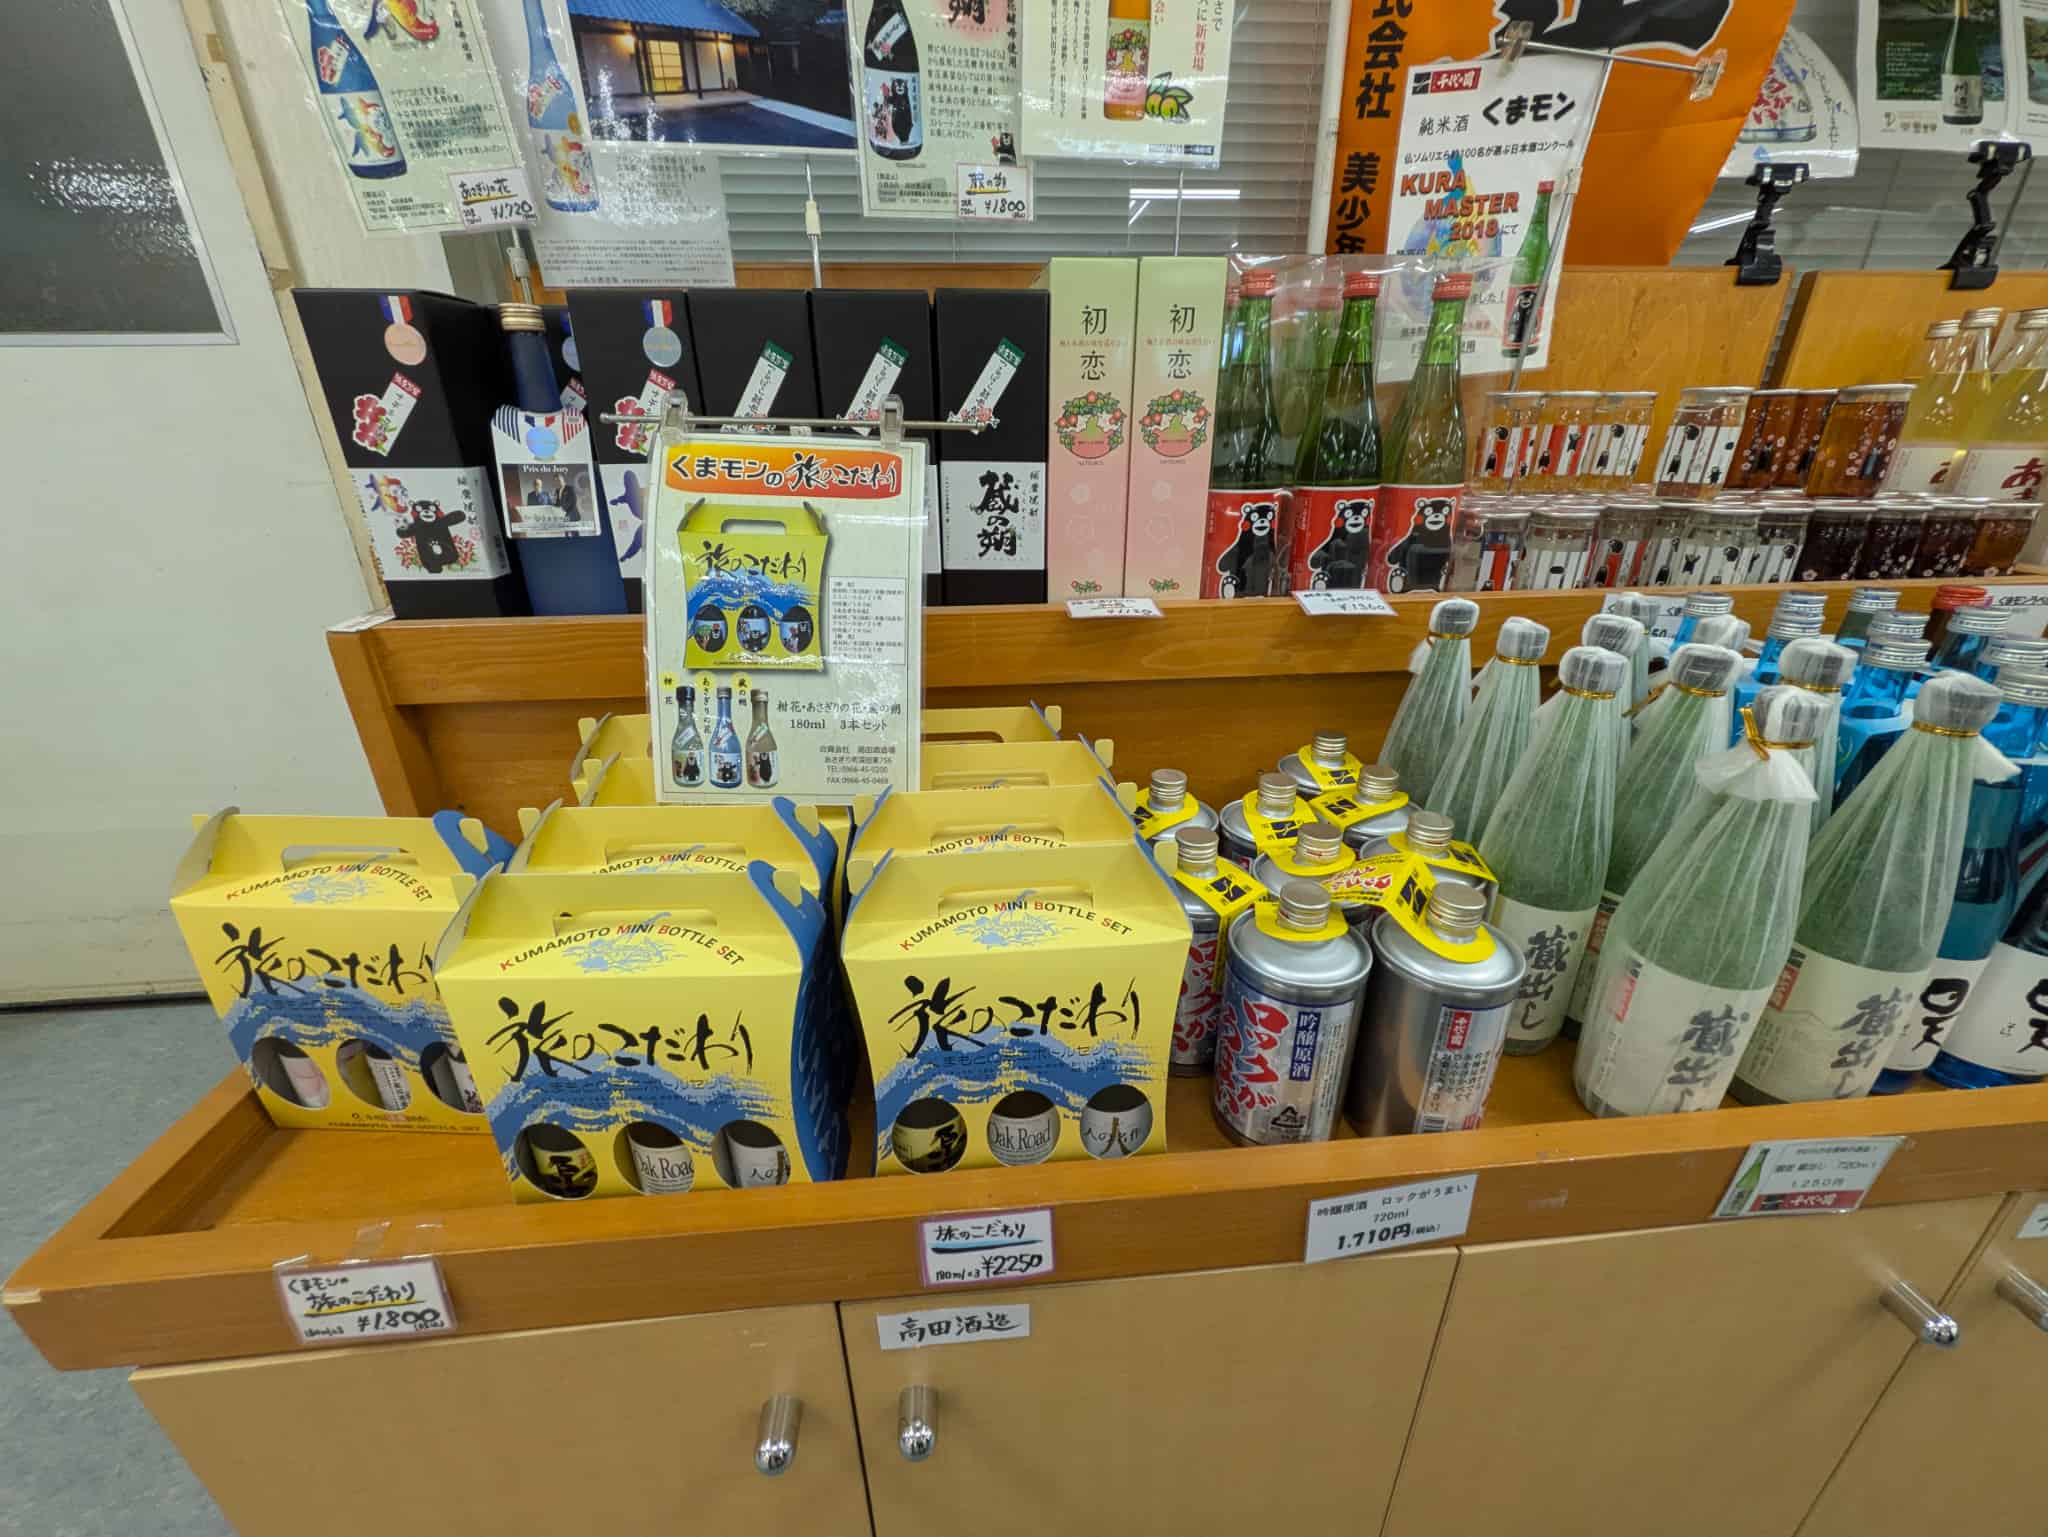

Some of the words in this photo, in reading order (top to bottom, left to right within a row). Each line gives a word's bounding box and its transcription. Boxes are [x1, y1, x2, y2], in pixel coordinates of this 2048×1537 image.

[1418, 114, 1470, 136] 純米酒
[1482, 92, 1576, 126] くまモン
[1400, 170, 1467, 197] KURA
[1424, 192, 1520, 220] MASTER
[1448, 219, 1500, 241] 2018
[1501, 224, 1520, 235] にて
[1081, 304, 1108, 381] 初恋
[1168, 303, 1196, 379] 初恋
[522, 464, 536, 473] Prix
[539, 465, 550, 473] du
[552, 465, 569, 474] Jury
[670, 452, 898, 492] くまモンの旅のこだわり
[977, 469, 1020, 557] 蔵の朔
[696, 540, 807, 583] 旅のこだわり
[790, 719, 826, 729] 180ml
[840, 718, 888, 731] 3本セット
[927, 837, 974, 855] AMOTO
[978, 833, 1008, 843] MINI
[594, 855, 655, 874] AMOTO
[658, 853, 692, 863] MINI
[226, 866, 332, 901] KUMAMOTO
[336, 863, 368, 873] MINI
[370, 864, 415, 888] BOTTLE
[412, 884, 433, 903] SET
[899, 905, 988, 951] KUMAMOTO
[993, 900, 1029, 913] MINI
[1033, 900, 1097, 921] BOTTLE
[1101, 916, 1134, 937] SET
[215, 921, 441, 1001] 旅のこだわり
[500, 927, 612, 972] KUMAMOTO
[616, 923, 656, 935] MINI
[658, 923, 717, 948] BOTTLE
[716, 944, 745, 967] SET
[1517, 923, 1578, 1030] 蔵出し
[888, 975, 1140, 1058] 旅のこだわり
[486, 996, 754, 1082] 旅のこだわり
[1292, 1013, 1318, 1078] 吟醸原酒
[1017, 1119, 1051, 1148] Road
[1317, 1199, 1368, 1217] 吟醸原酒
[1381, 1183, 1469, 1206] ロックがうまい
[1373, 1208, 1410, 1224] 720ml
[934, 1218, 1026, 1242] 旅のこだわり
[980, 1253, 1043, 1278] ¥2250
[288, 1276, 351, 1295] くまモンの
[305, 1281, 417, 1313] 旅のこだわり
[898, 1311, 1023, 1343] 高田酒造
